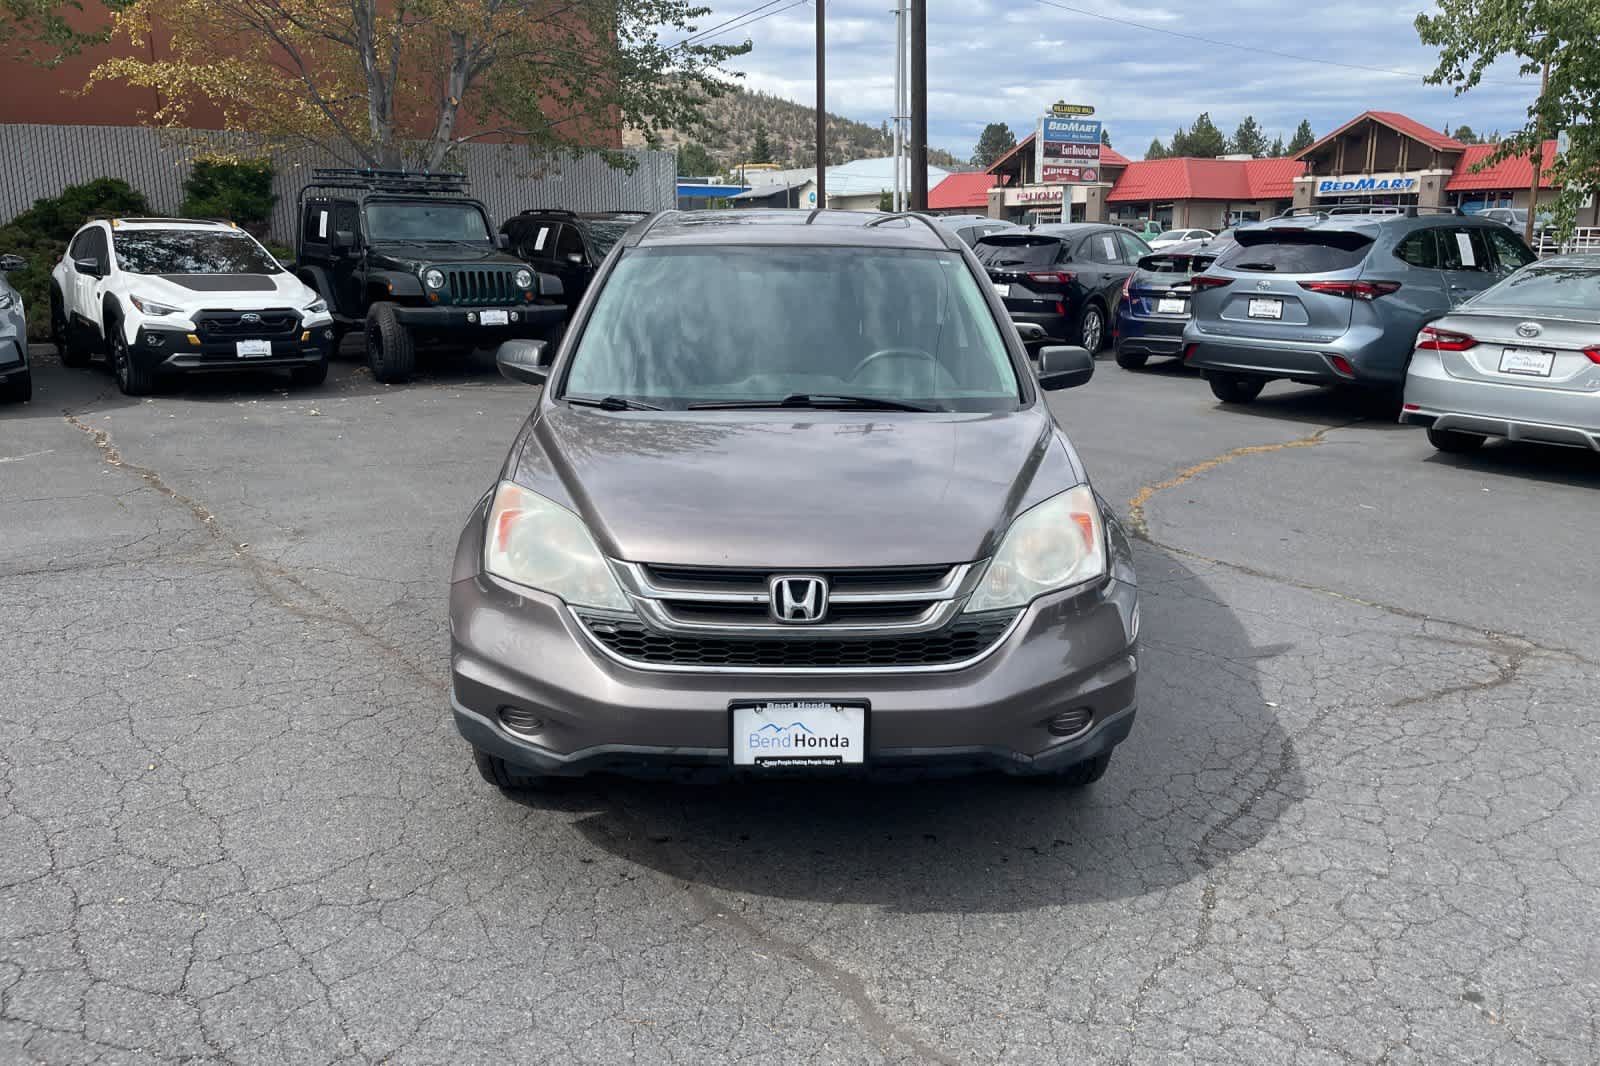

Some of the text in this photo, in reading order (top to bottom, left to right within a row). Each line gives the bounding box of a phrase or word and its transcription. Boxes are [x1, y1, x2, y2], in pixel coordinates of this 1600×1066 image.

[797, 701, 832, 711] Honda
[749, 733, 850, 748] Bend Honda
